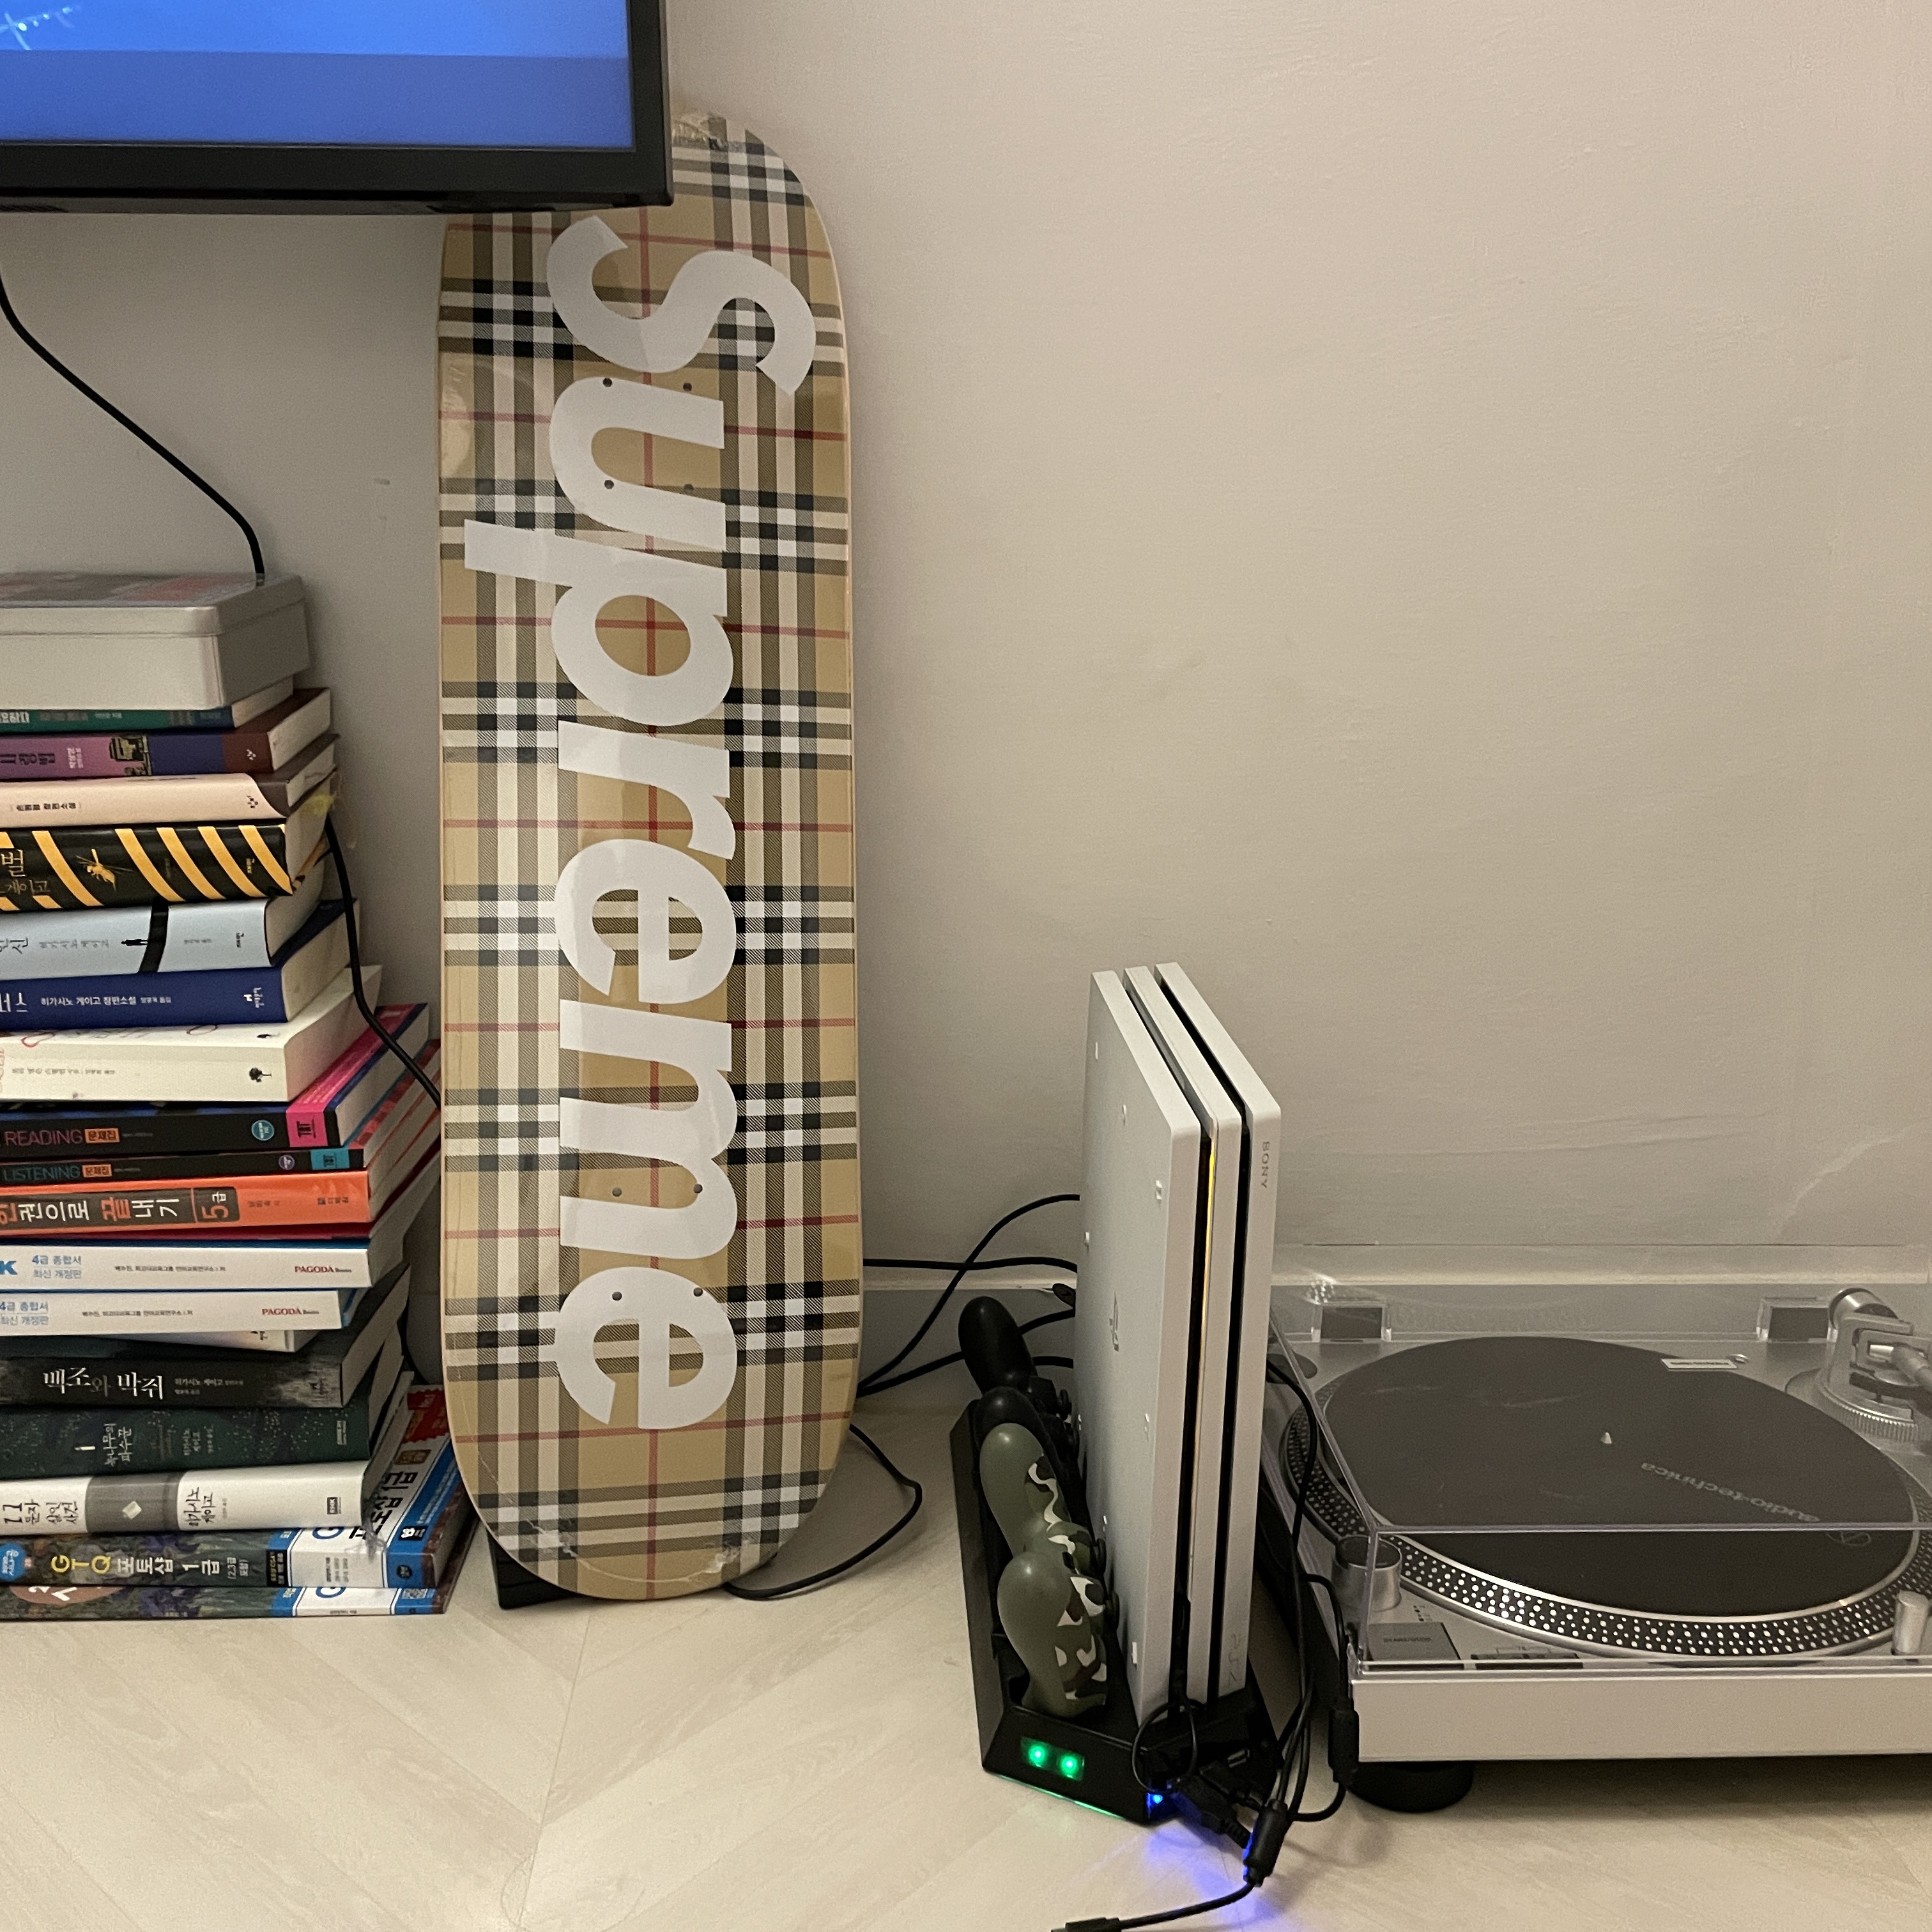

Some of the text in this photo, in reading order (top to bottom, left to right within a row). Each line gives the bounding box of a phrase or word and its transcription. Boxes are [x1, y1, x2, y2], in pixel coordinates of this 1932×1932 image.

[464, 215, 816, 1429] Supreme
[40, 997, 73, 1006] 히가시노
[76, 997, 101, 1006] 게이고
[4, 1128, 84, 1146] READING
[3, 1165, 81, 1181] LISTENING
[1261, 1141, 1270, 1188] SONY
[101, 1197, 180, 1222] 끝내기
[32, 1255, 82, 1265] 4급 종합서
[55, 1269, 82, 1278] 개정판
[261, 1308, 302, 1316] PAGODA
[43, 1367, 164, 1400] 백조와 박쥐
[102, 1422, 119, 1468] 녹나무의
[118, 1426, 134, 1462] 파수꾼
[1641, 1462, 1820, 1522] audio-technica
[24, 1499, 40, 1525] 문자
[46, 1501, 63, 1526] 살인
[63, 1501, 78, 1524] 사건
[183, 1486, 202, 1527] 히가시노
[201, 1491, 217, 1524] 게이고
[51, 1554, 220, 1575] GTQ 포토샵 1급
